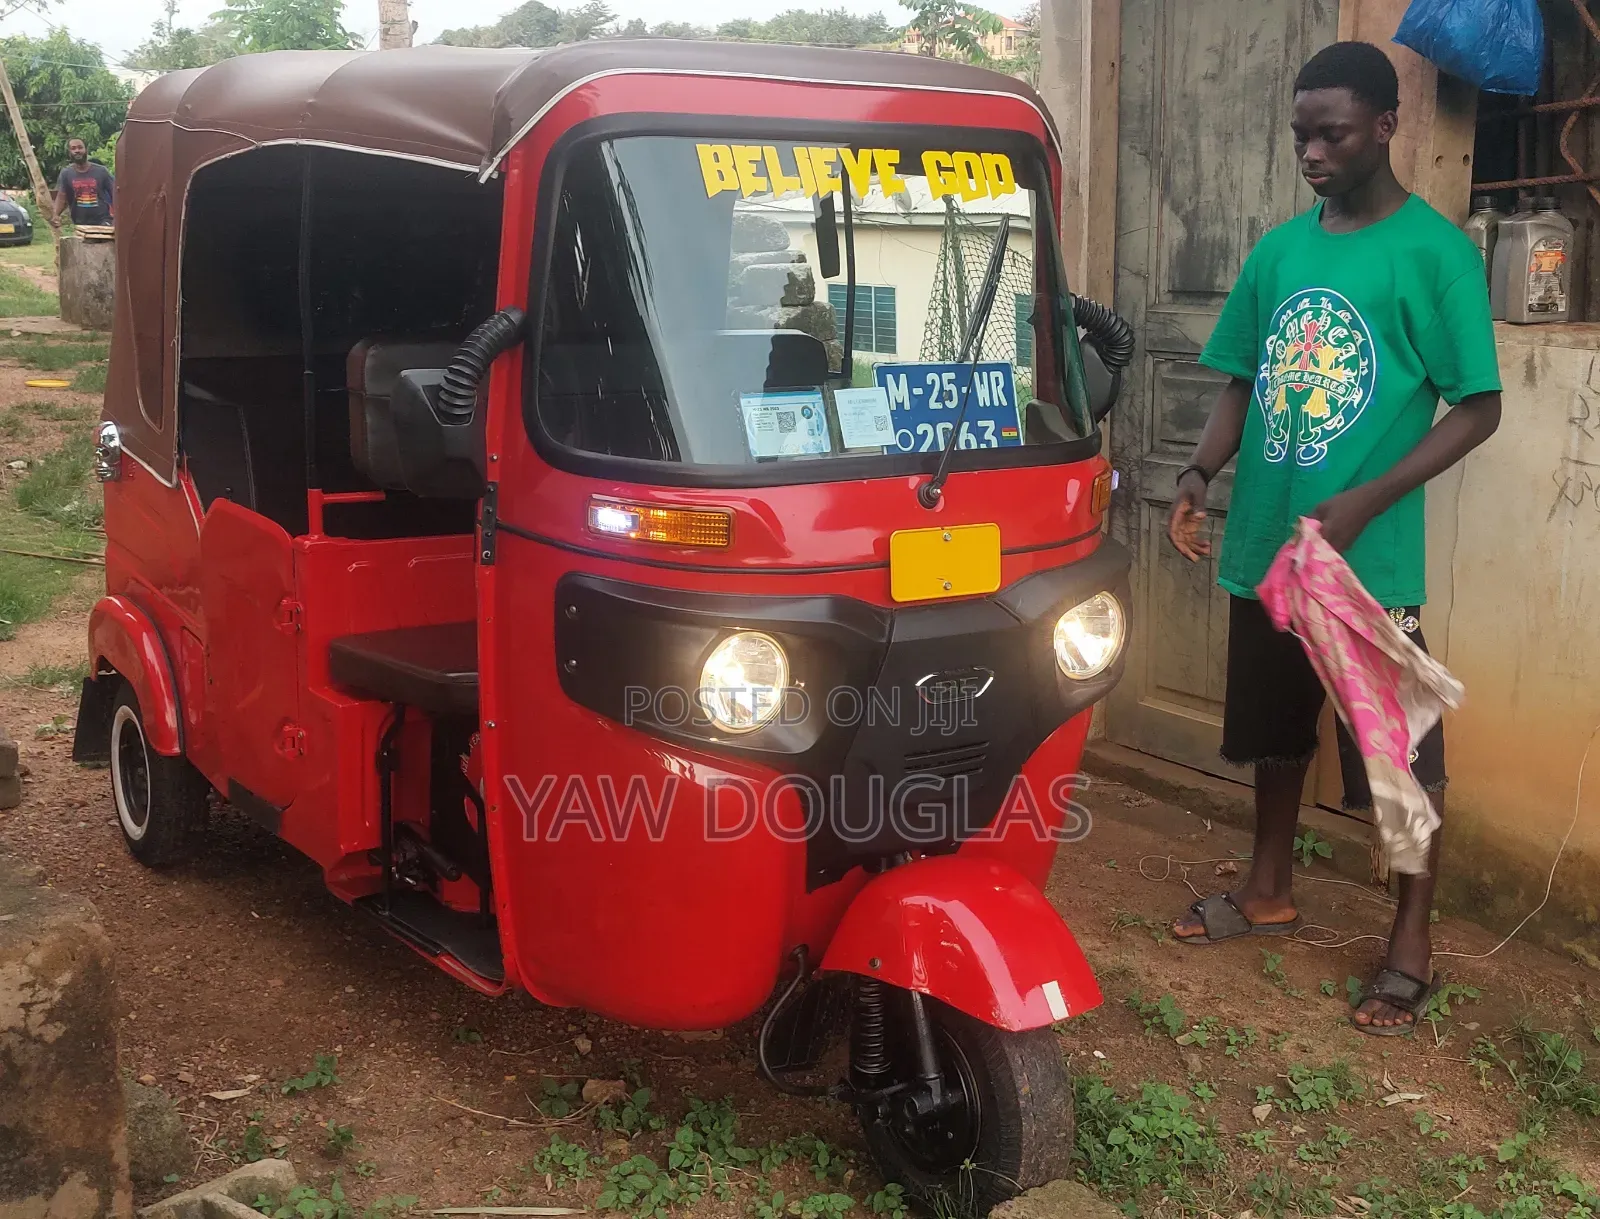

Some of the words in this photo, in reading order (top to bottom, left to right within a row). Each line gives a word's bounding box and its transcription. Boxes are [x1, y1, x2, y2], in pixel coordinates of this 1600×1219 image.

[695, 143, 906, 200] BELIEVE
[921, 150, 1017, 203] GOD
[886, 371, 1008, 411] M-25-WR
